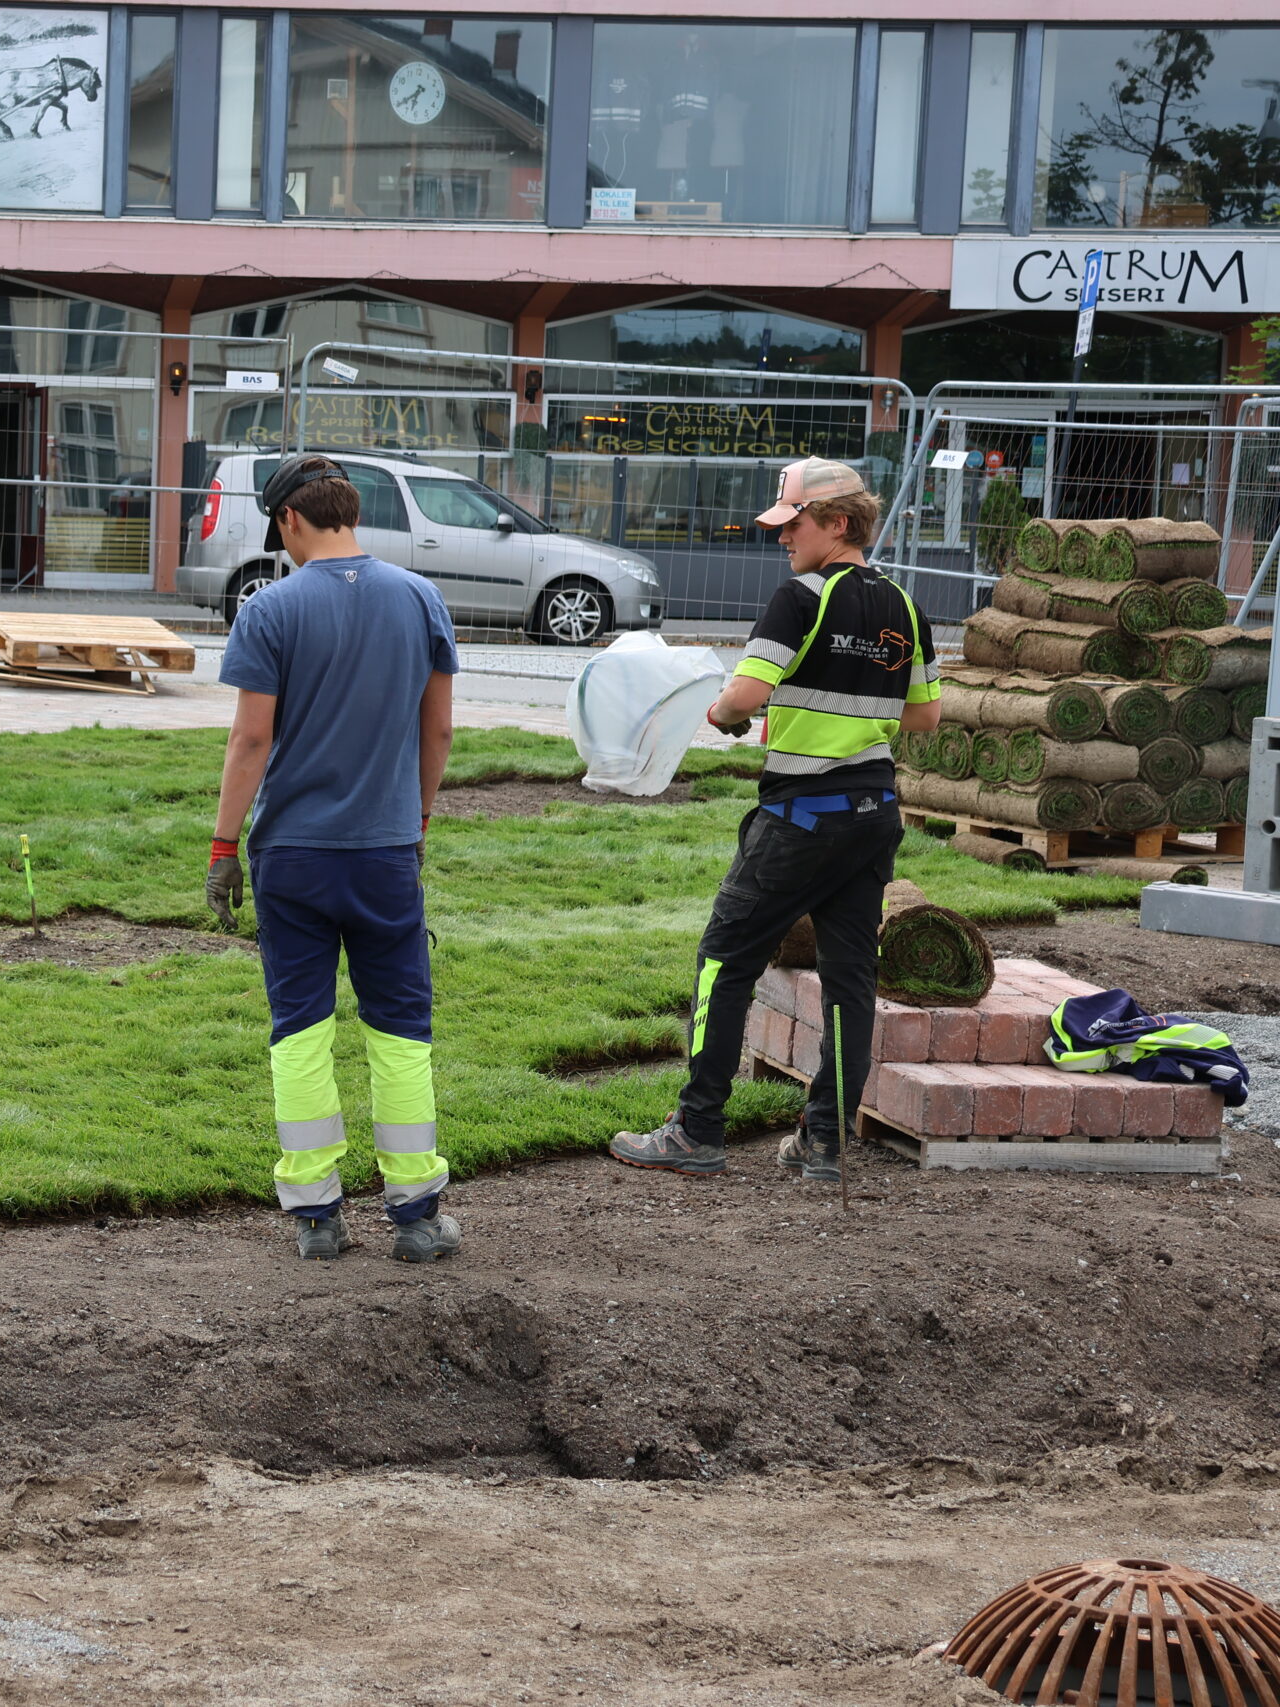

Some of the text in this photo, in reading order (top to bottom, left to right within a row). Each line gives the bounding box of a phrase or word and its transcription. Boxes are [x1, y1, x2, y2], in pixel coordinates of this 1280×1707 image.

[594, 191, 633, 199] LOKALER
[612, 200, 629, 208] LEIE
[1013, 249, 1248, 304] CATRUM
[1084, 259, 1098, 303] P
[1064, 287, 1165, 302] SISERI
[242, 376, 262, 384] BAS
[292, 396, 420, 429] CASTRUM
[321, 417, 375, 428] SPISERI
[646, 404, 775, 437] CASTRUM
[674, 426, 730, 436] SPISERI
[597, 434, 812, 455] Restaurant
